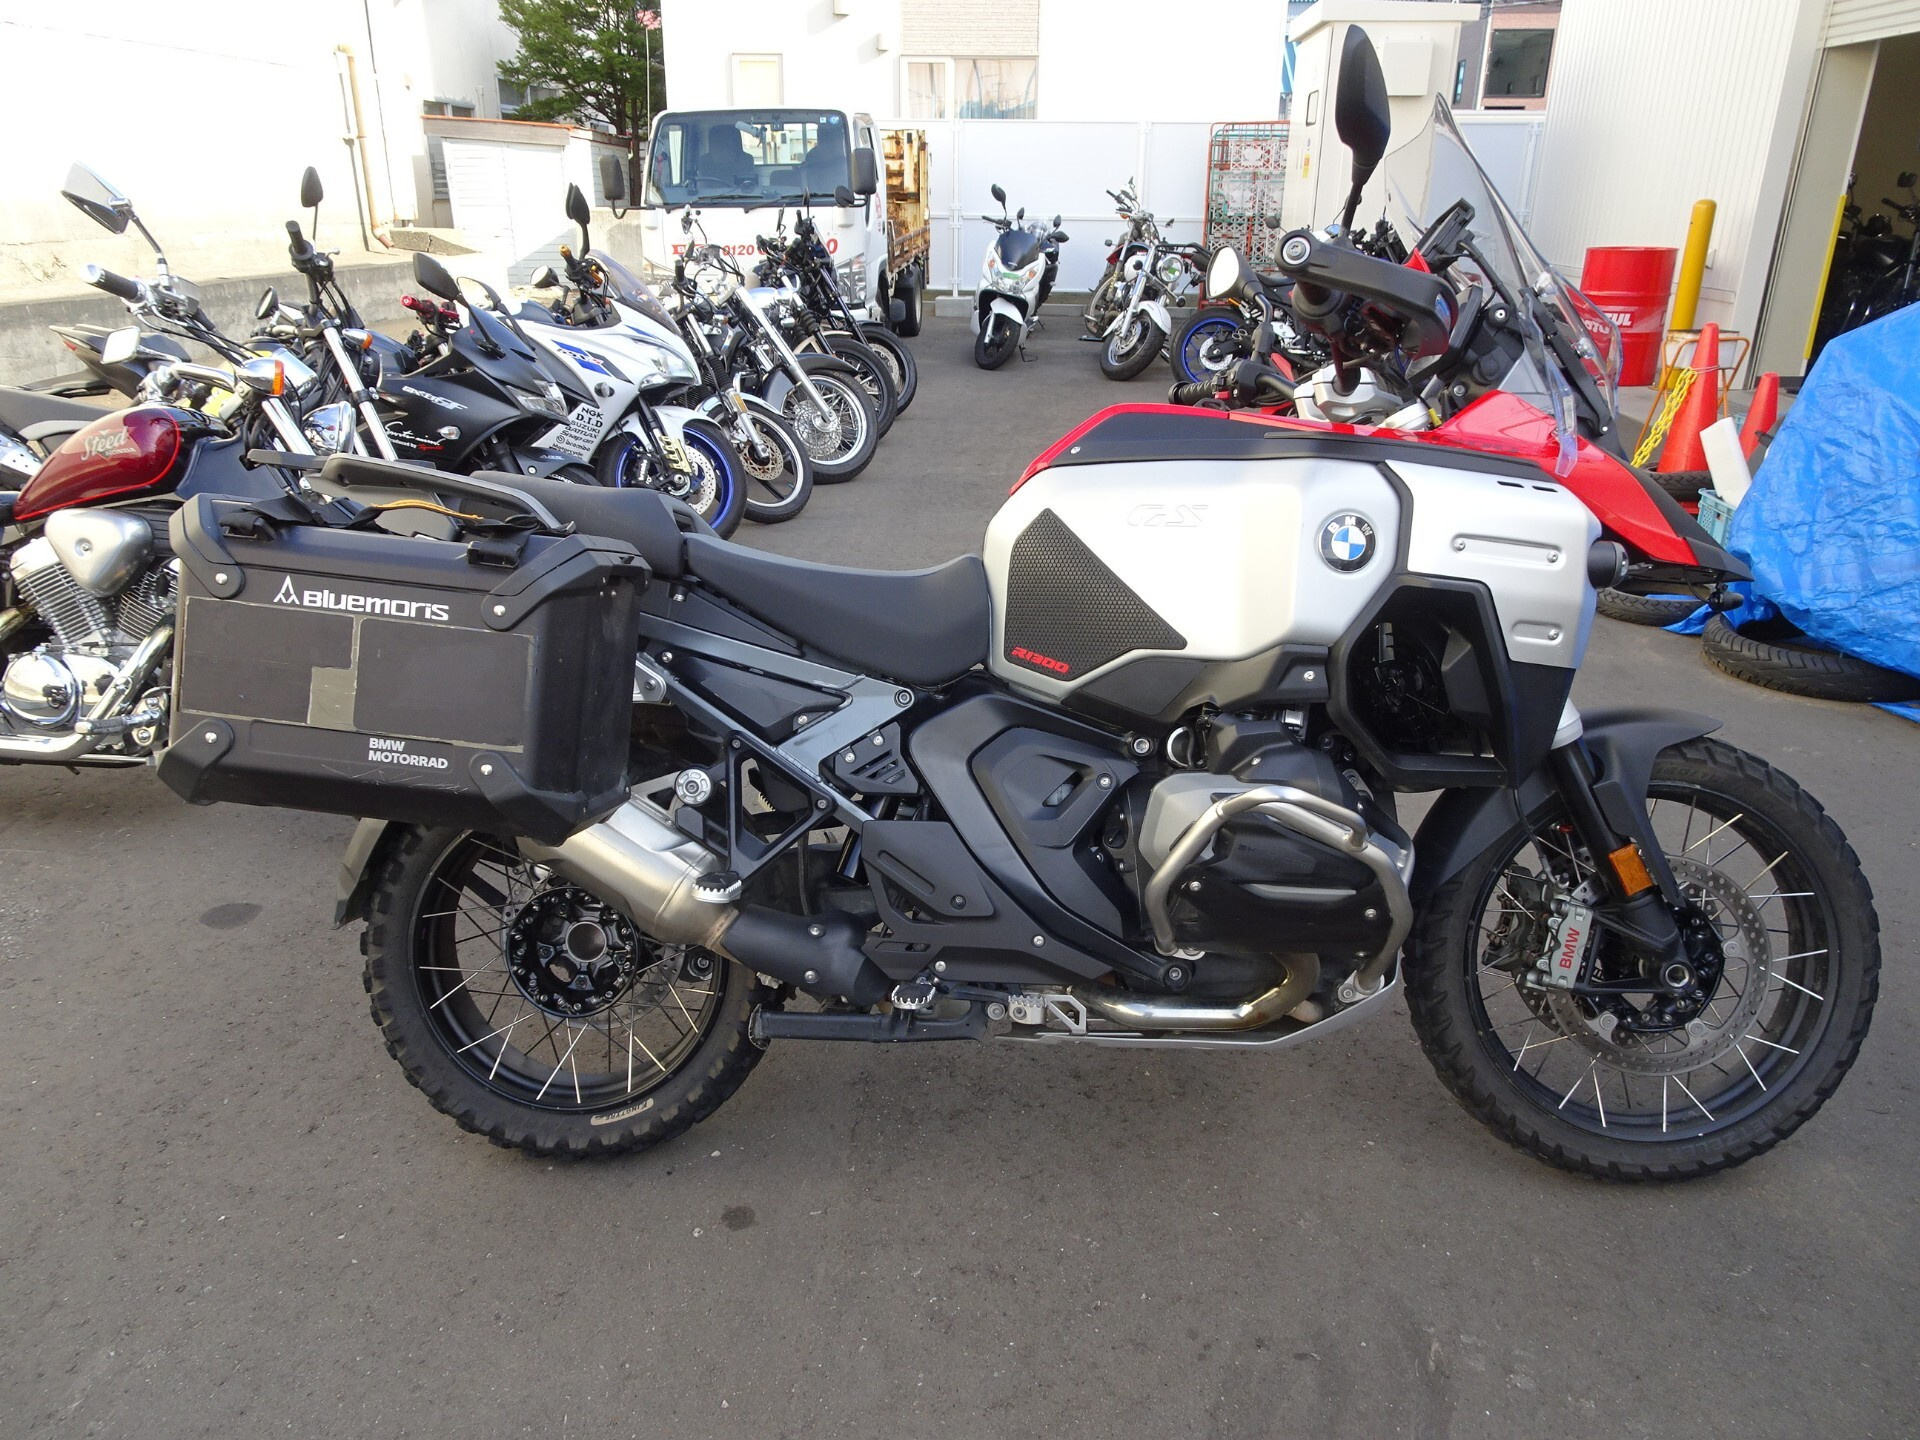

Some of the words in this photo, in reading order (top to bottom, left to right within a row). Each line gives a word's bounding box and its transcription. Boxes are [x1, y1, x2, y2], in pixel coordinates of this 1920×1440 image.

[722, 244, 755, 257] 0120
[576, 412, 603, 428] D.I.D
[581, 406, 604, 419] NGK
[570, 420, 601, 434] SUZUKI
[80, 425, 129, 461] Steed
[565, 439, 591, 452] brembo
[1327, 515, 1373, 537] BMW
[1011, 646, 1070, 674] R1300
[369, 737, 406, 752] BMW
[368, 750, 449, 770] MOTORRAD
[1559, 926, 1581, 970] BMW
